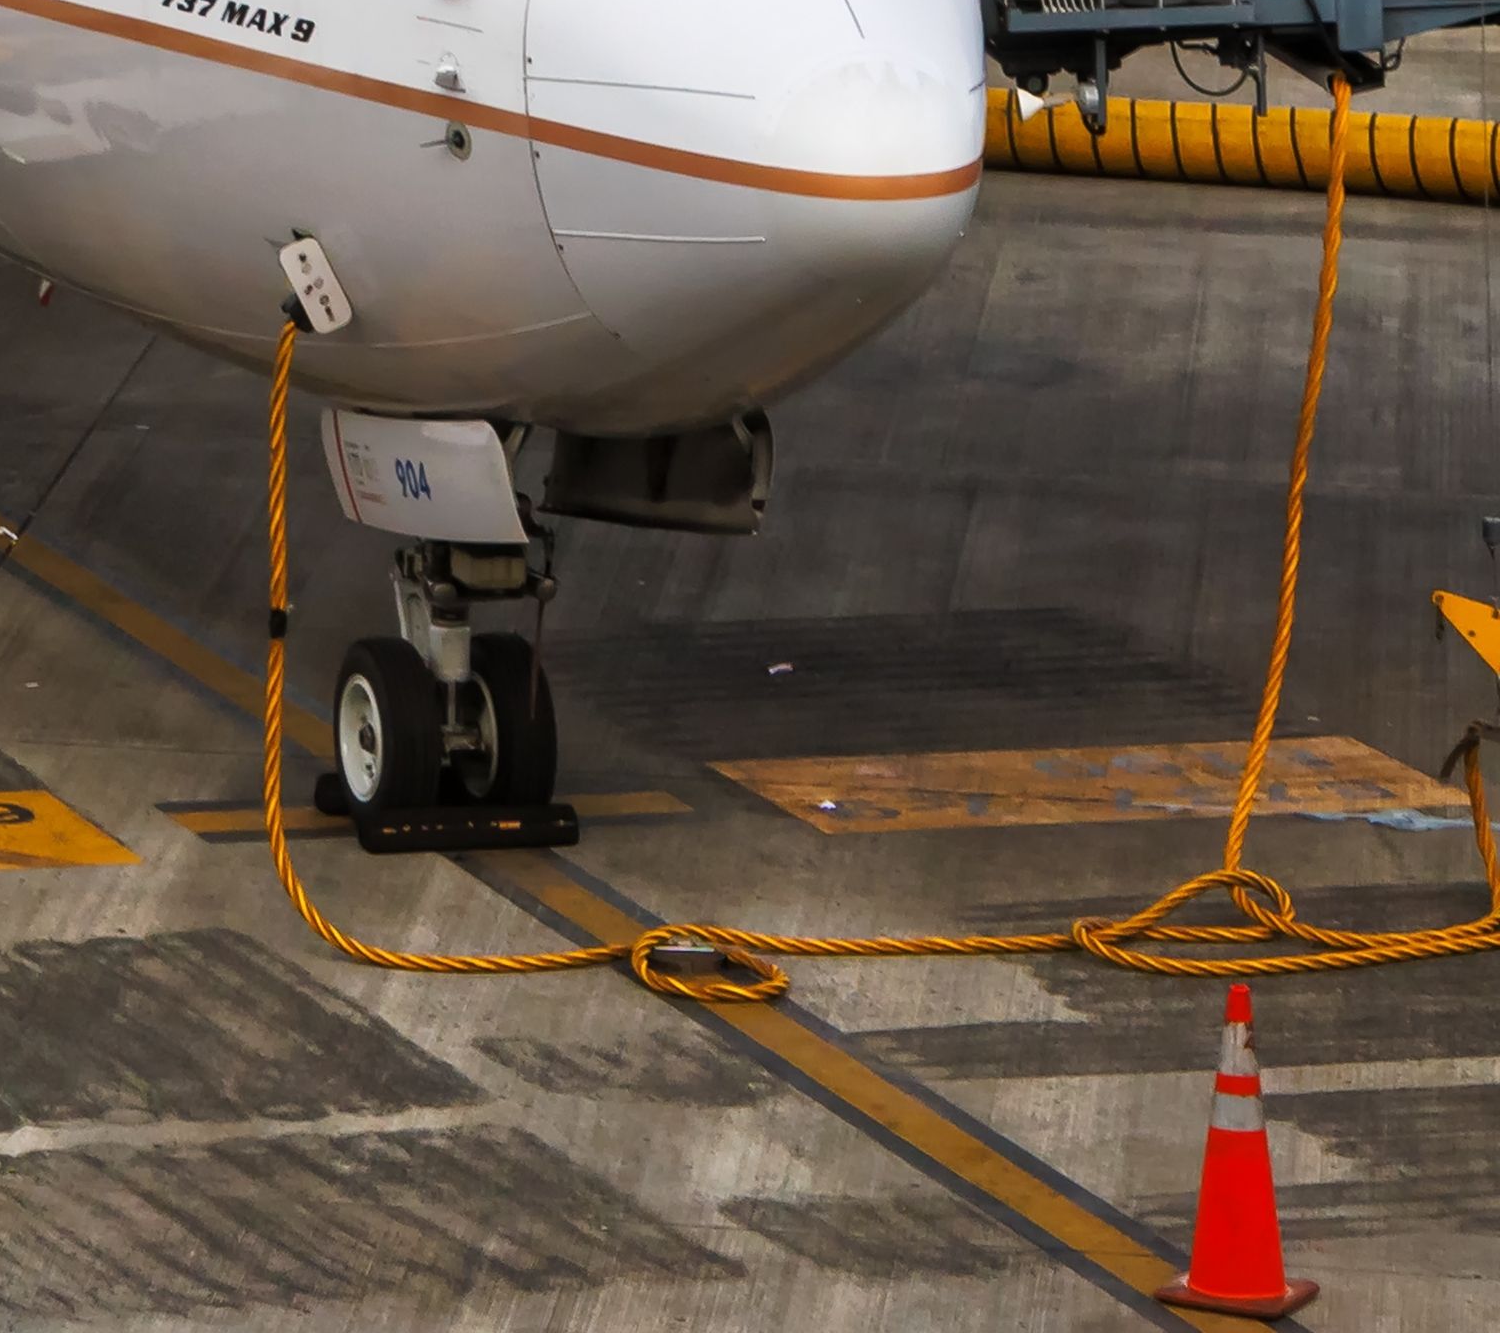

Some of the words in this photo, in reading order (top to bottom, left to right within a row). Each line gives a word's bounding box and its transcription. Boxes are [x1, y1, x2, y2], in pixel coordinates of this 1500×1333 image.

[222, 0, 290, 37] MAX
[290, 17, 316, 44] 9
[395, 457, 432, 501] 904
